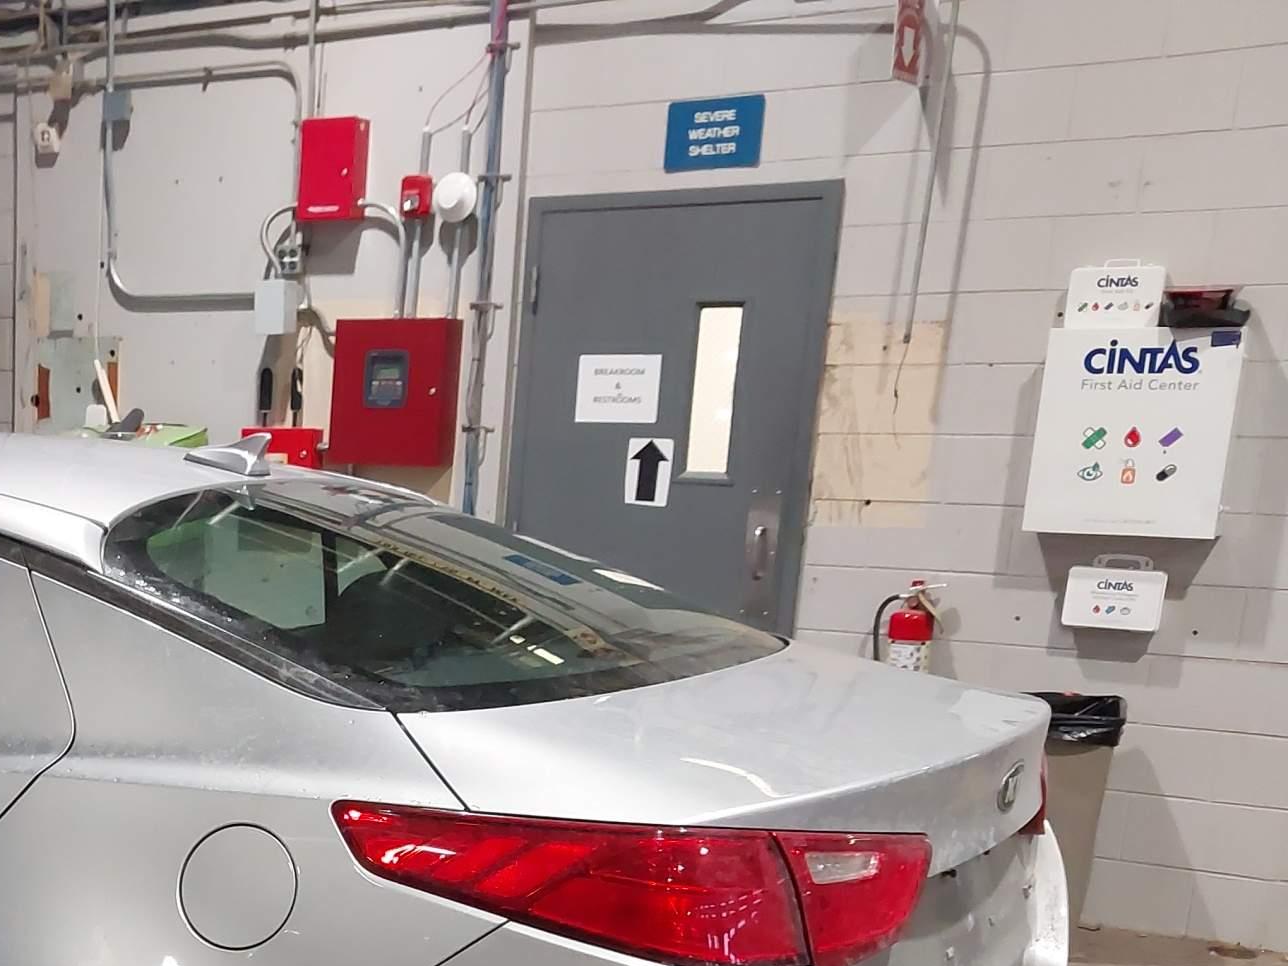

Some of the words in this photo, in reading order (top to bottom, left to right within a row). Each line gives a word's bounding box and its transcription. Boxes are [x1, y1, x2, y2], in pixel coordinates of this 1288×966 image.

[694, 109, 737, 123] SEVERE
[688, 125, 740, 140] WEATHER
[688, 142, 736, 156] SHELTER
[1081, 379, 1112, 391] First
[1117, 379, 1143, 391] Aid
[1148, 379, 1200, 391] Center
